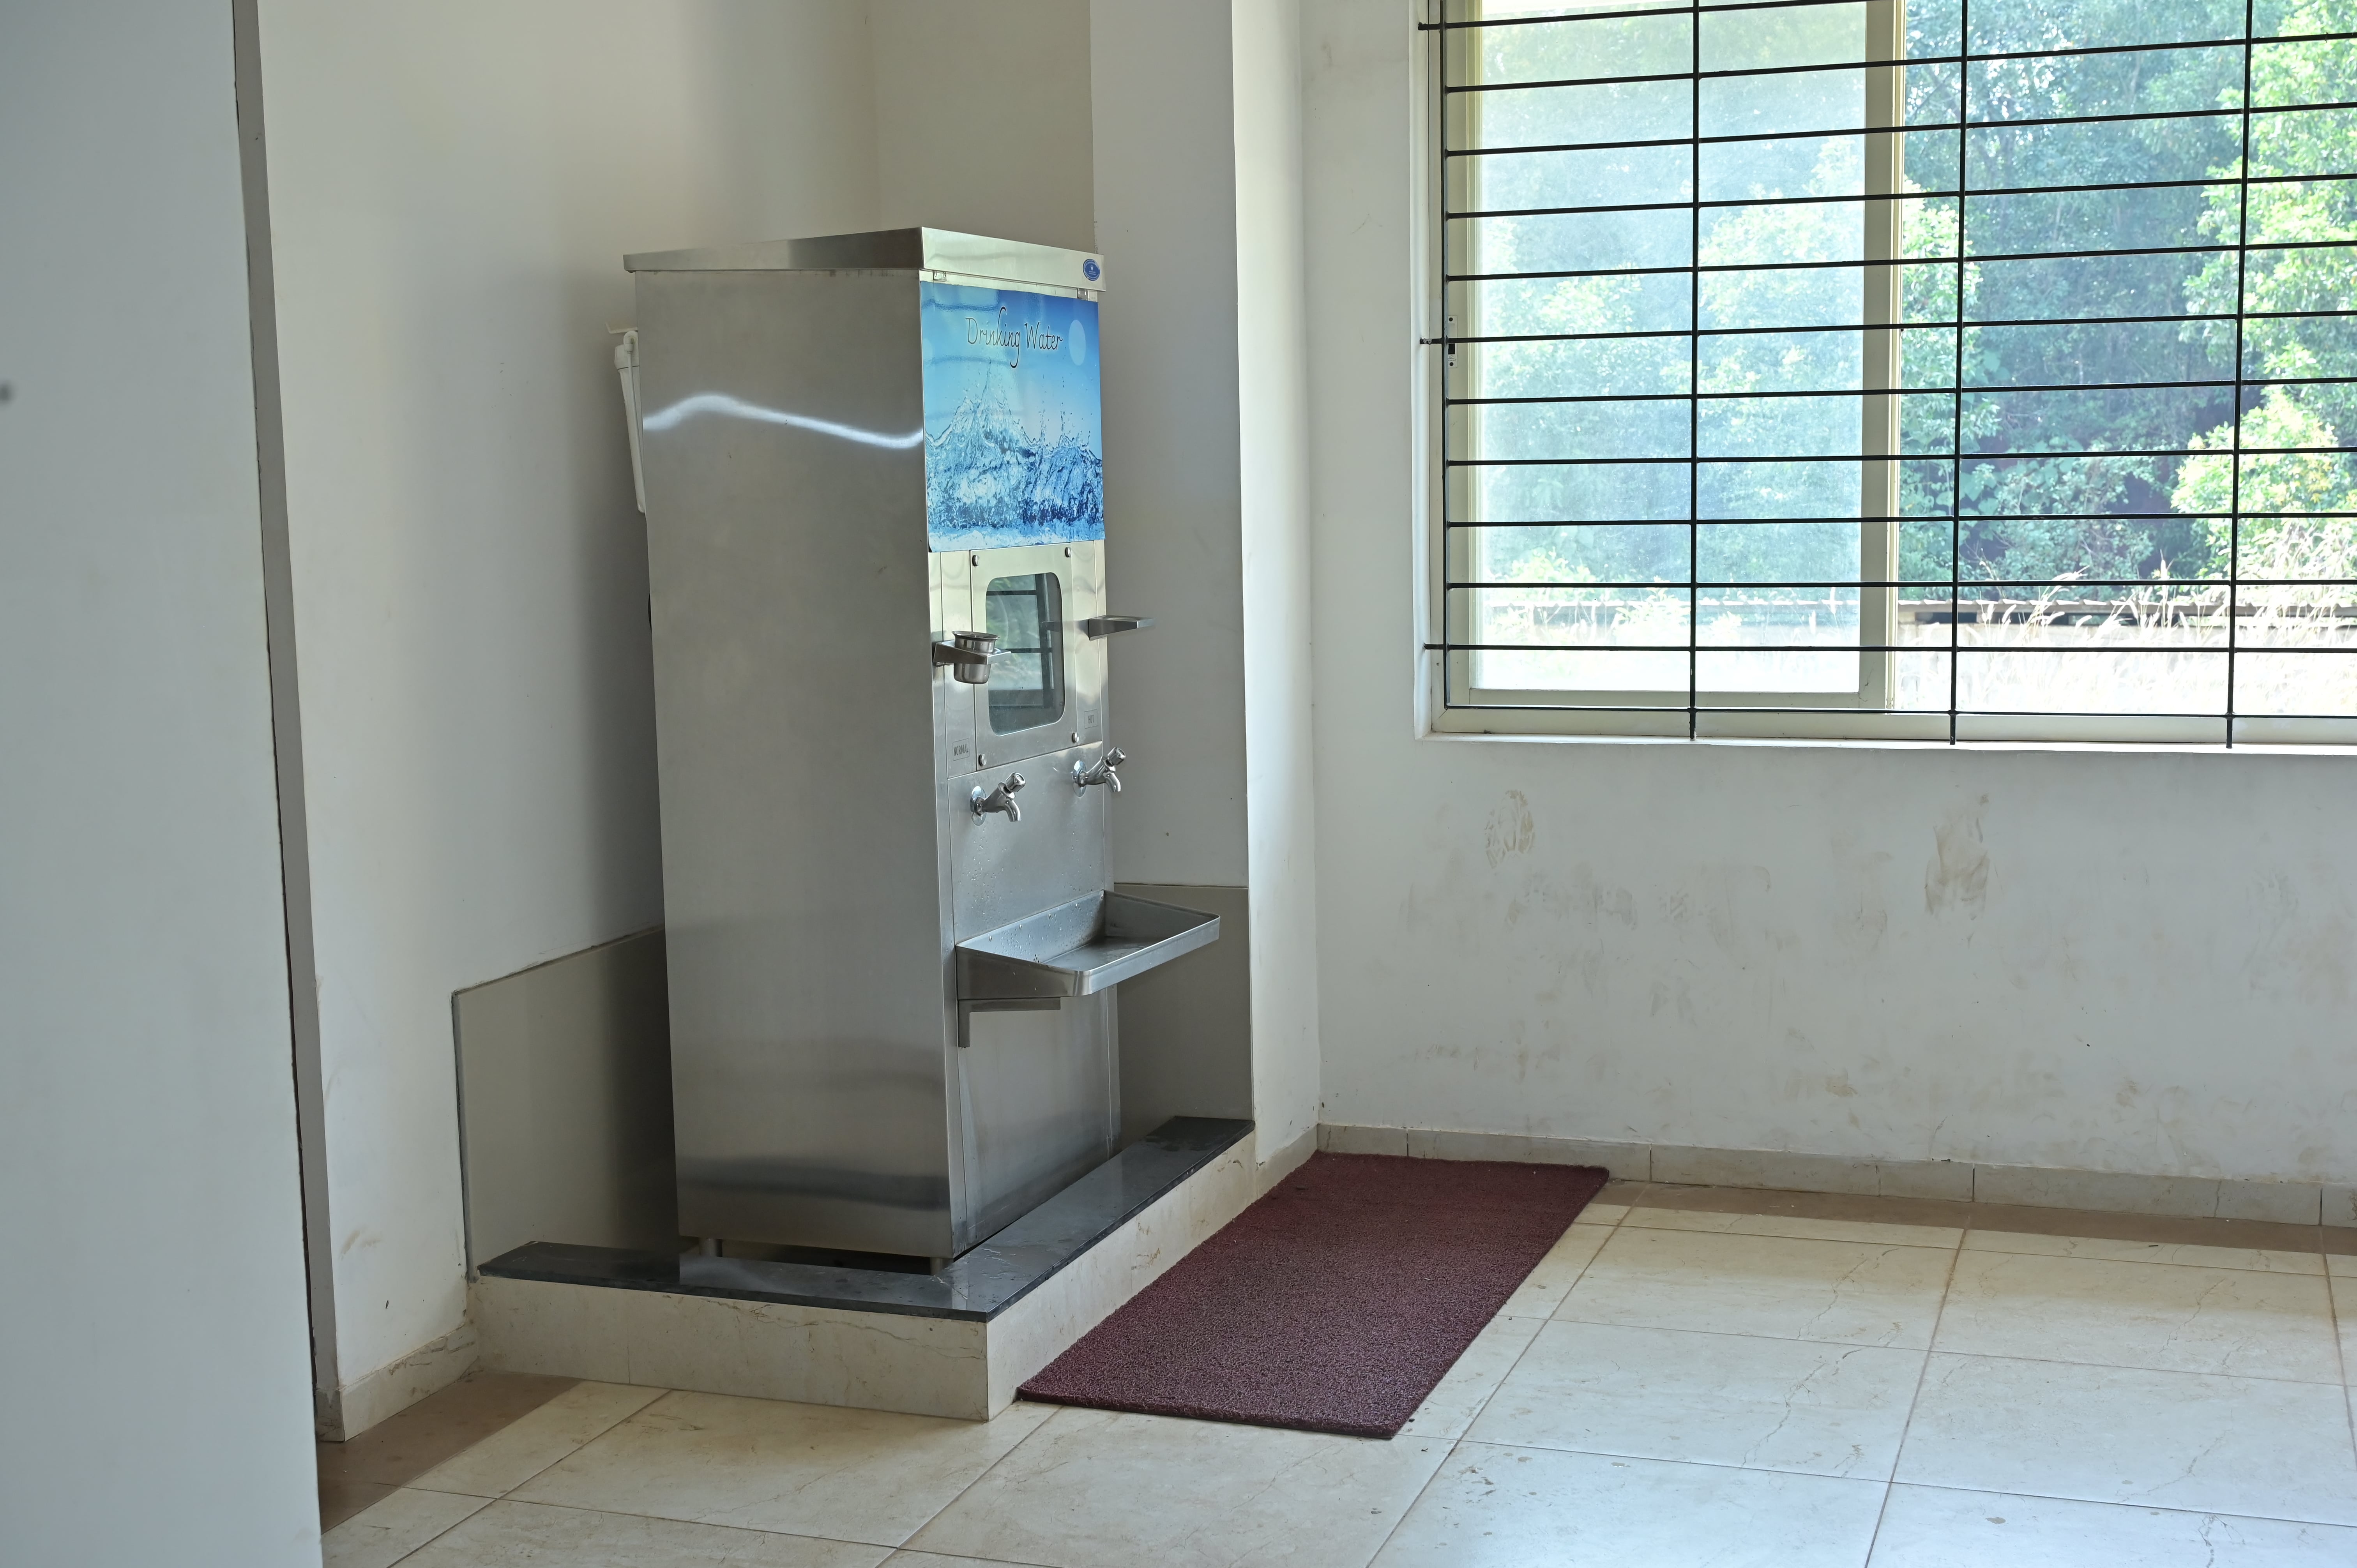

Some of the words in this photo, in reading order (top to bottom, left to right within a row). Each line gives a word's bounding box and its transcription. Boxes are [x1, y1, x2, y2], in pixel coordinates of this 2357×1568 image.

[965, 306, 1020, 368] Drinking
[1024, 322, 1063, 350] Water
[954, 743, 968, 756] NORMAL
